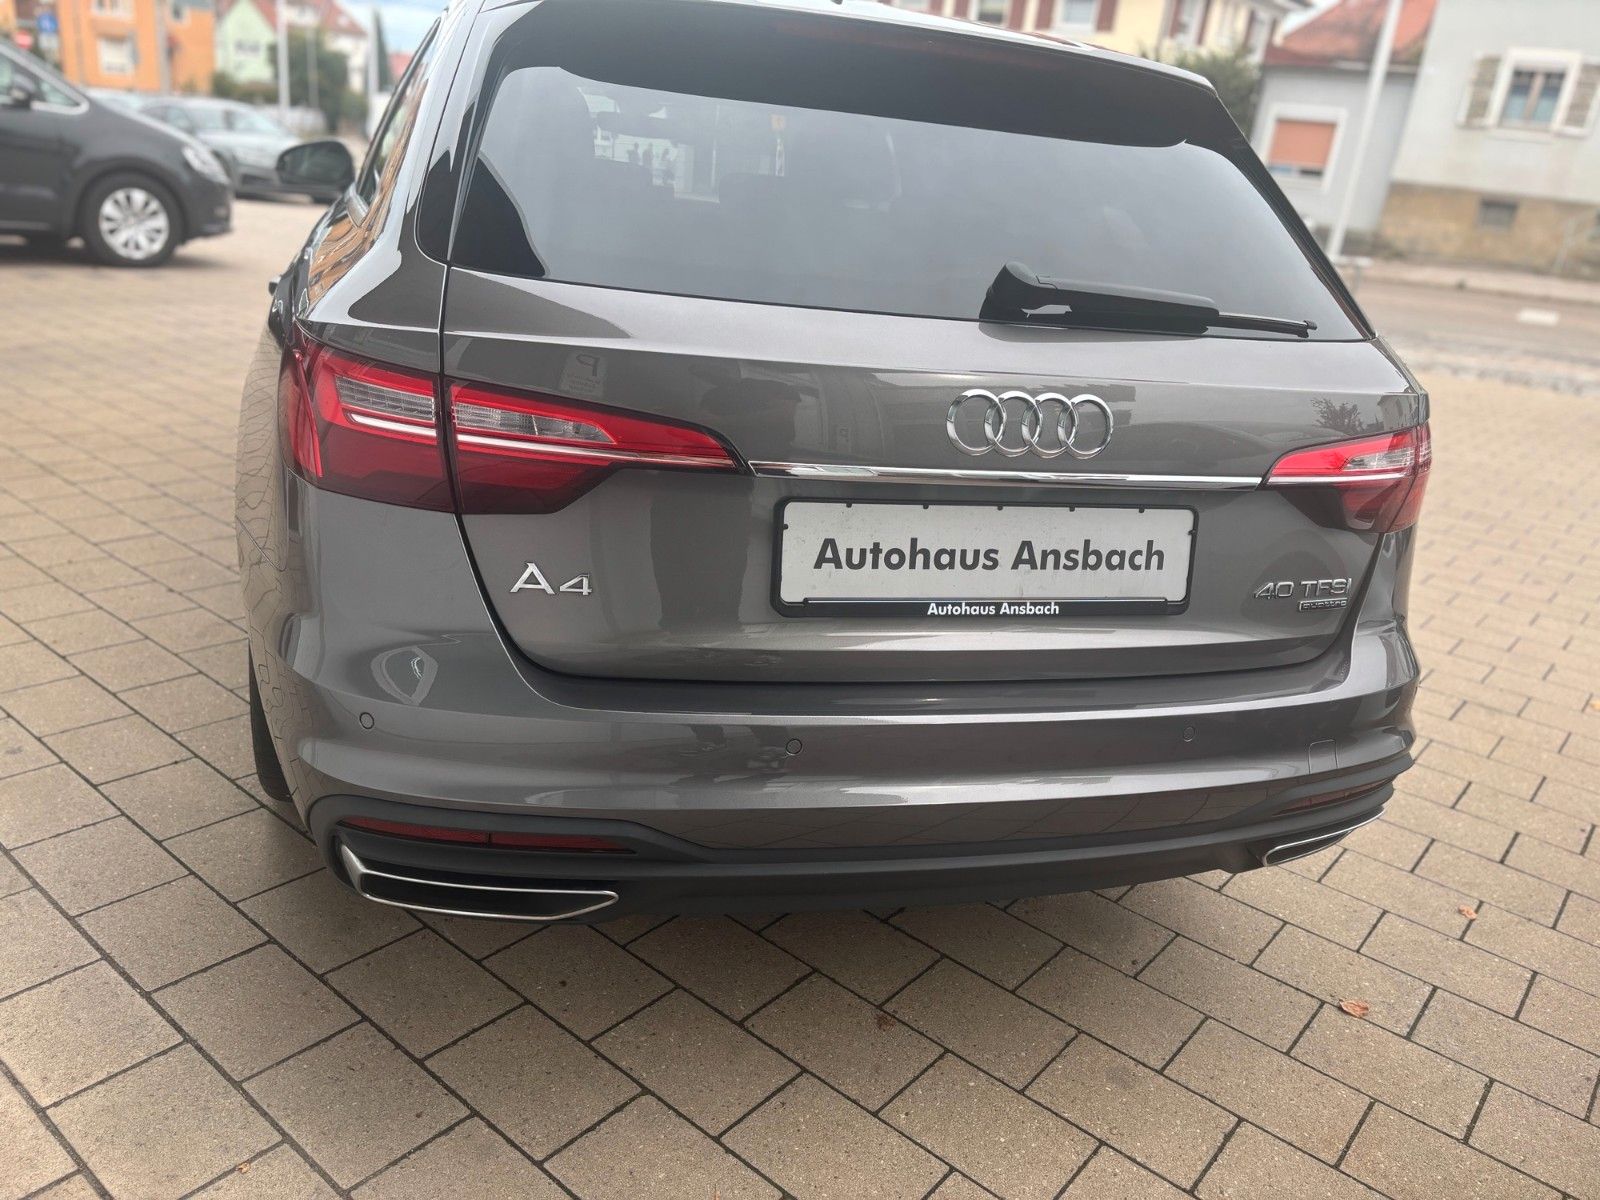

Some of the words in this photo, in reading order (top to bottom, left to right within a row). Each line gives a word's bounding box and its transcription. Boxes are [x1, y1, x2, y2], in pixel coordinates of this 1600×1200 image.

[813, 537, 1000, 571] Autohaus
[1010, 539, 1165, 571] Ansbach
[509, 562, 592, 596] A4
[1254, 582, 1294, 599] 40
[1300, 578, 1352, 597] TFSI
[927, 602, 996, 615] Autohaus
[1000, 602, 1060, 615] Ansbach
